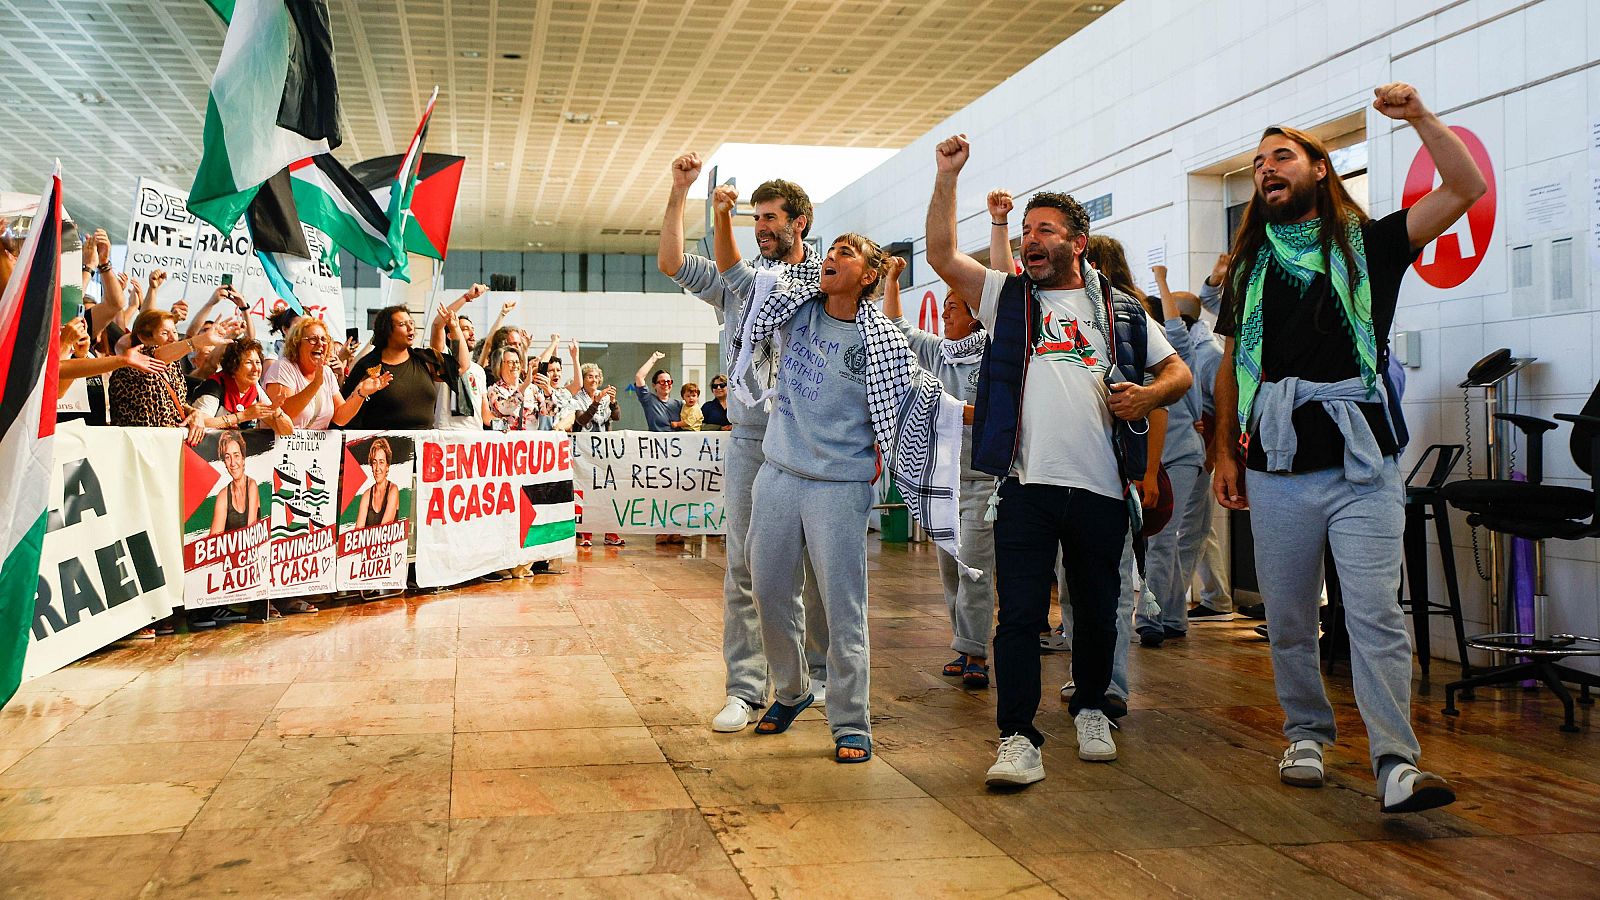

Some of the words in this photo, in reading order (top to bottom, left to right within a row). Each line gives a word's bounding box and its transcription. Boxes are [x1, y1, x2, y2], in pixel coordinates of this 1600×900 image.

[192, 273, 220, 286] ENRE
[286, 440, 320, 451] FLOTILLA
[306, 430, 327, 440] SUMUD
[590, 436, 625, 460] RIU
[638, 436, 682, 460] FINS
[422, 440, 574, 482] BENVINGUDE
[592, 464, 617, 491] LA
[631, 463, 723, 492] RESISTÈ
[194, 520, 269, 566] BENVINGUDA
[270, 527, 334, 565] ENVINGUDA
[344, 521, 405, 553] BENVINGUDA
[223, 555, 233, 572] A
[360, 548, 368, 562] A
[370, 543, 391, 561] CASA
[206, 565, 261, 595] LAURA
[280, 556, 320, 586] CASA
[350, 557, 391, 580] LAURA
[30, 529, 167, 642] RAEL
